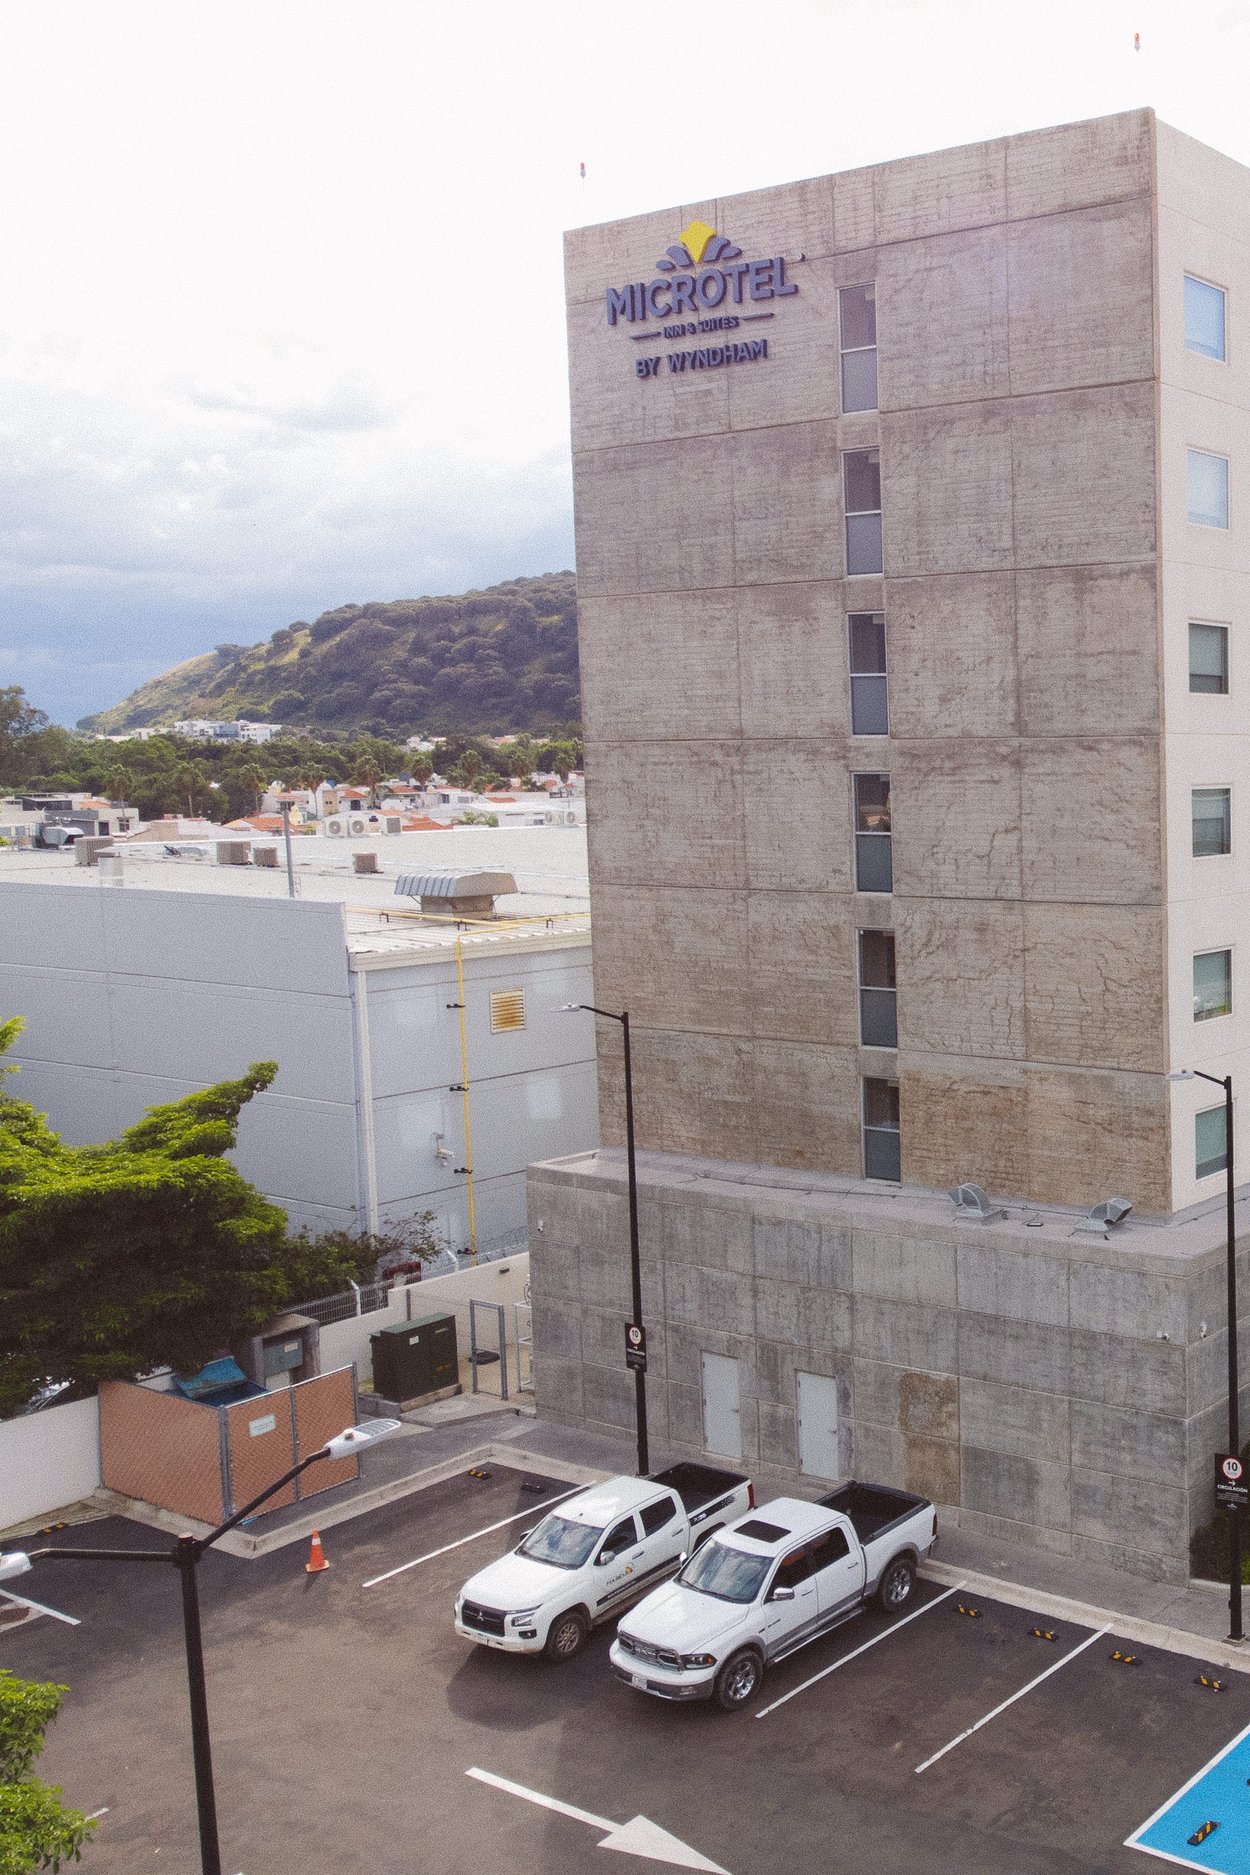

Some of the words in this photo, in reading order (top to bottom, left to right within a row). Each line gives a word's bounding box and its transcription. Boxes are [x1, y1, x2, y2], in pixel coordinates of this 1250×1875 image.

[606, 257, 799, 325] MICROTEL
[664, 324, 686, 338] INN
[686, 323, 697, 335] &
[696, 315, 739, 332] SUITES
[635, 356, 661, 378] BY
[667, 339, 768, 373] WYNDHAM
[631, 1329, 639, 1338] 10
[1226, 1461, 1238, 1472] 10
